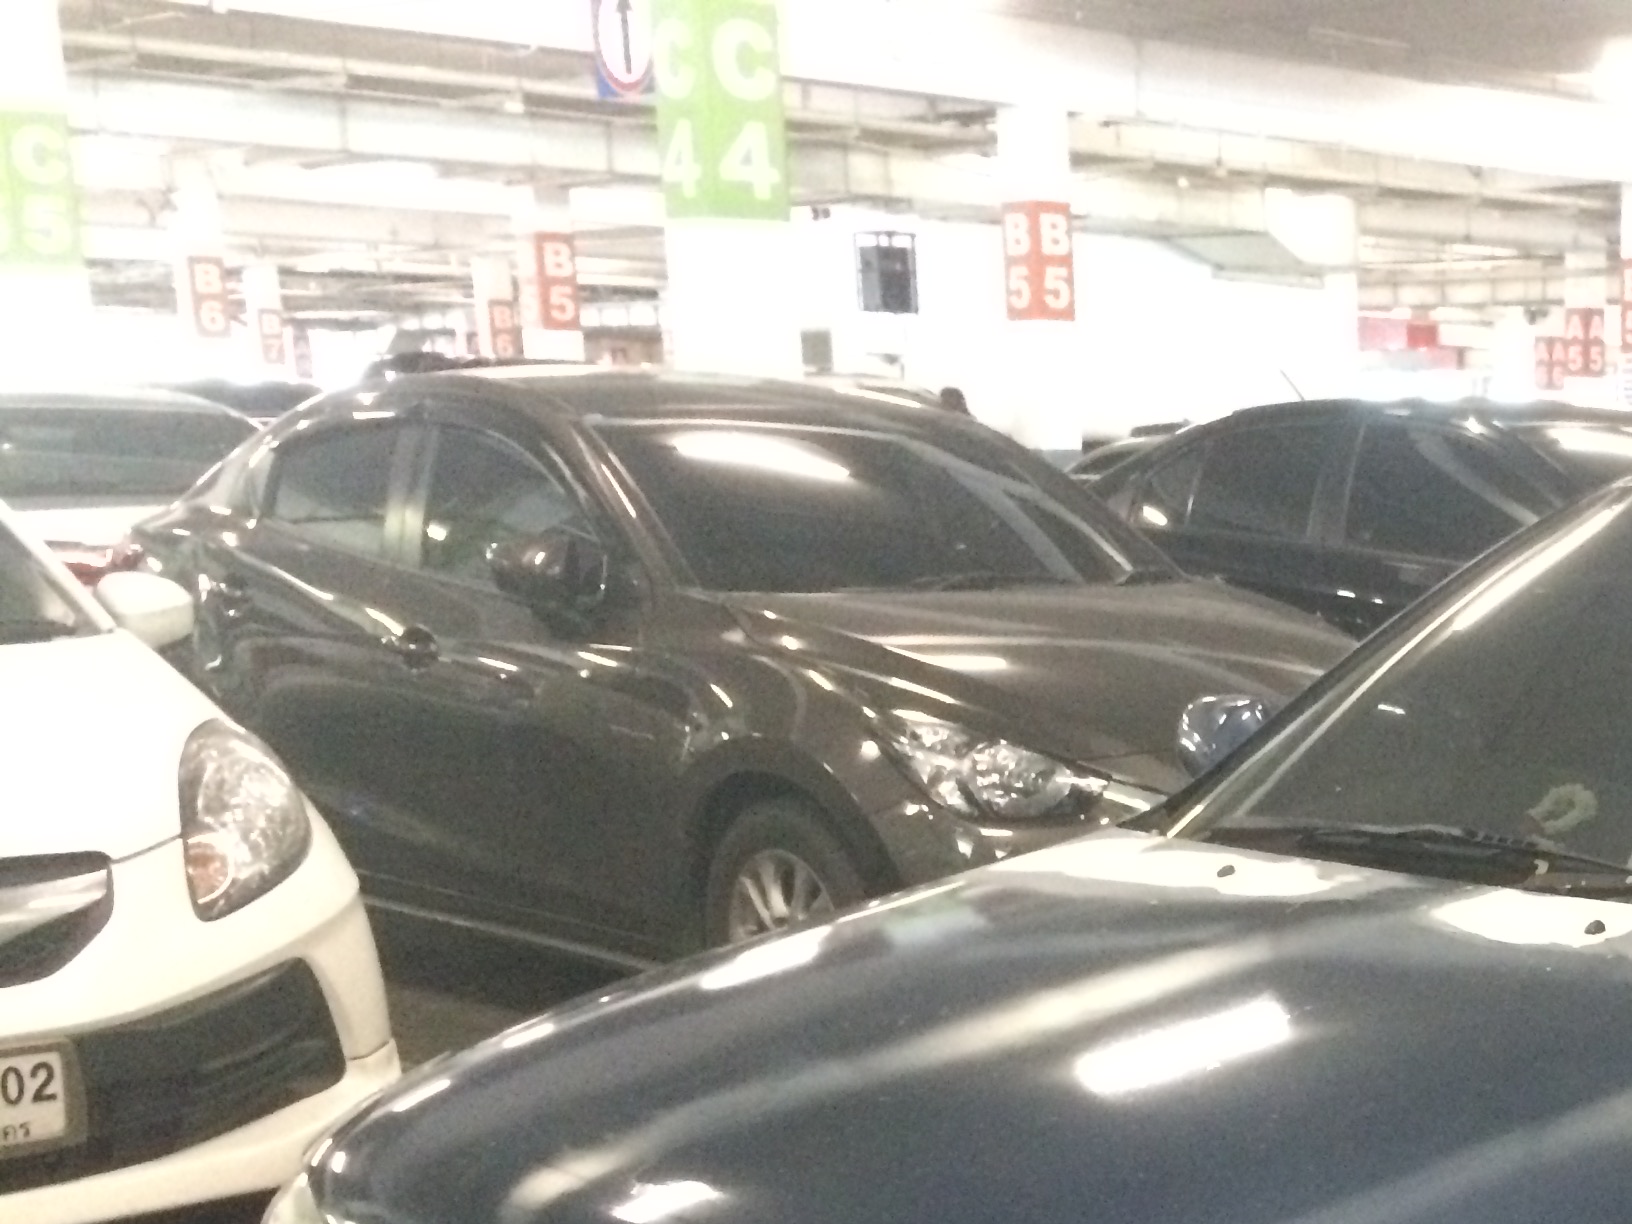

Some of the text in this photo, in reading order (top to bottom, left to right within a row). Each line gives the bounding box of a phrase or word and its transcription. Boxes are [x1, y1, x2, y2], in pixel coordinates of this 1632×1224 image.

[653, 17, 696, 100] C
[712, 18, 776, 101] C
[11, 125, 67, 184] C
[663, 117, 702, 199] 4
[719, 121, 780, 200] 4
[23, 194, 72, 254] 5
[1005, 212, 1031, 257] B
[1039, 213, 1069, 255] B
[194, 264, 223, 293] B
[543, 242, 574, 277] B
[549, 285, 576, 321] 5
[1009, 265, 1031, 309] 5
[1044, 266, 1071, 309] 5
[200, 300, 226, 332] 6
[1566, 315, 1584, 339] A
[1589, 316, 1604, 339] A
[1568, 345, 1583, 371] 5
[1590, 346, 1602, 371] 5
